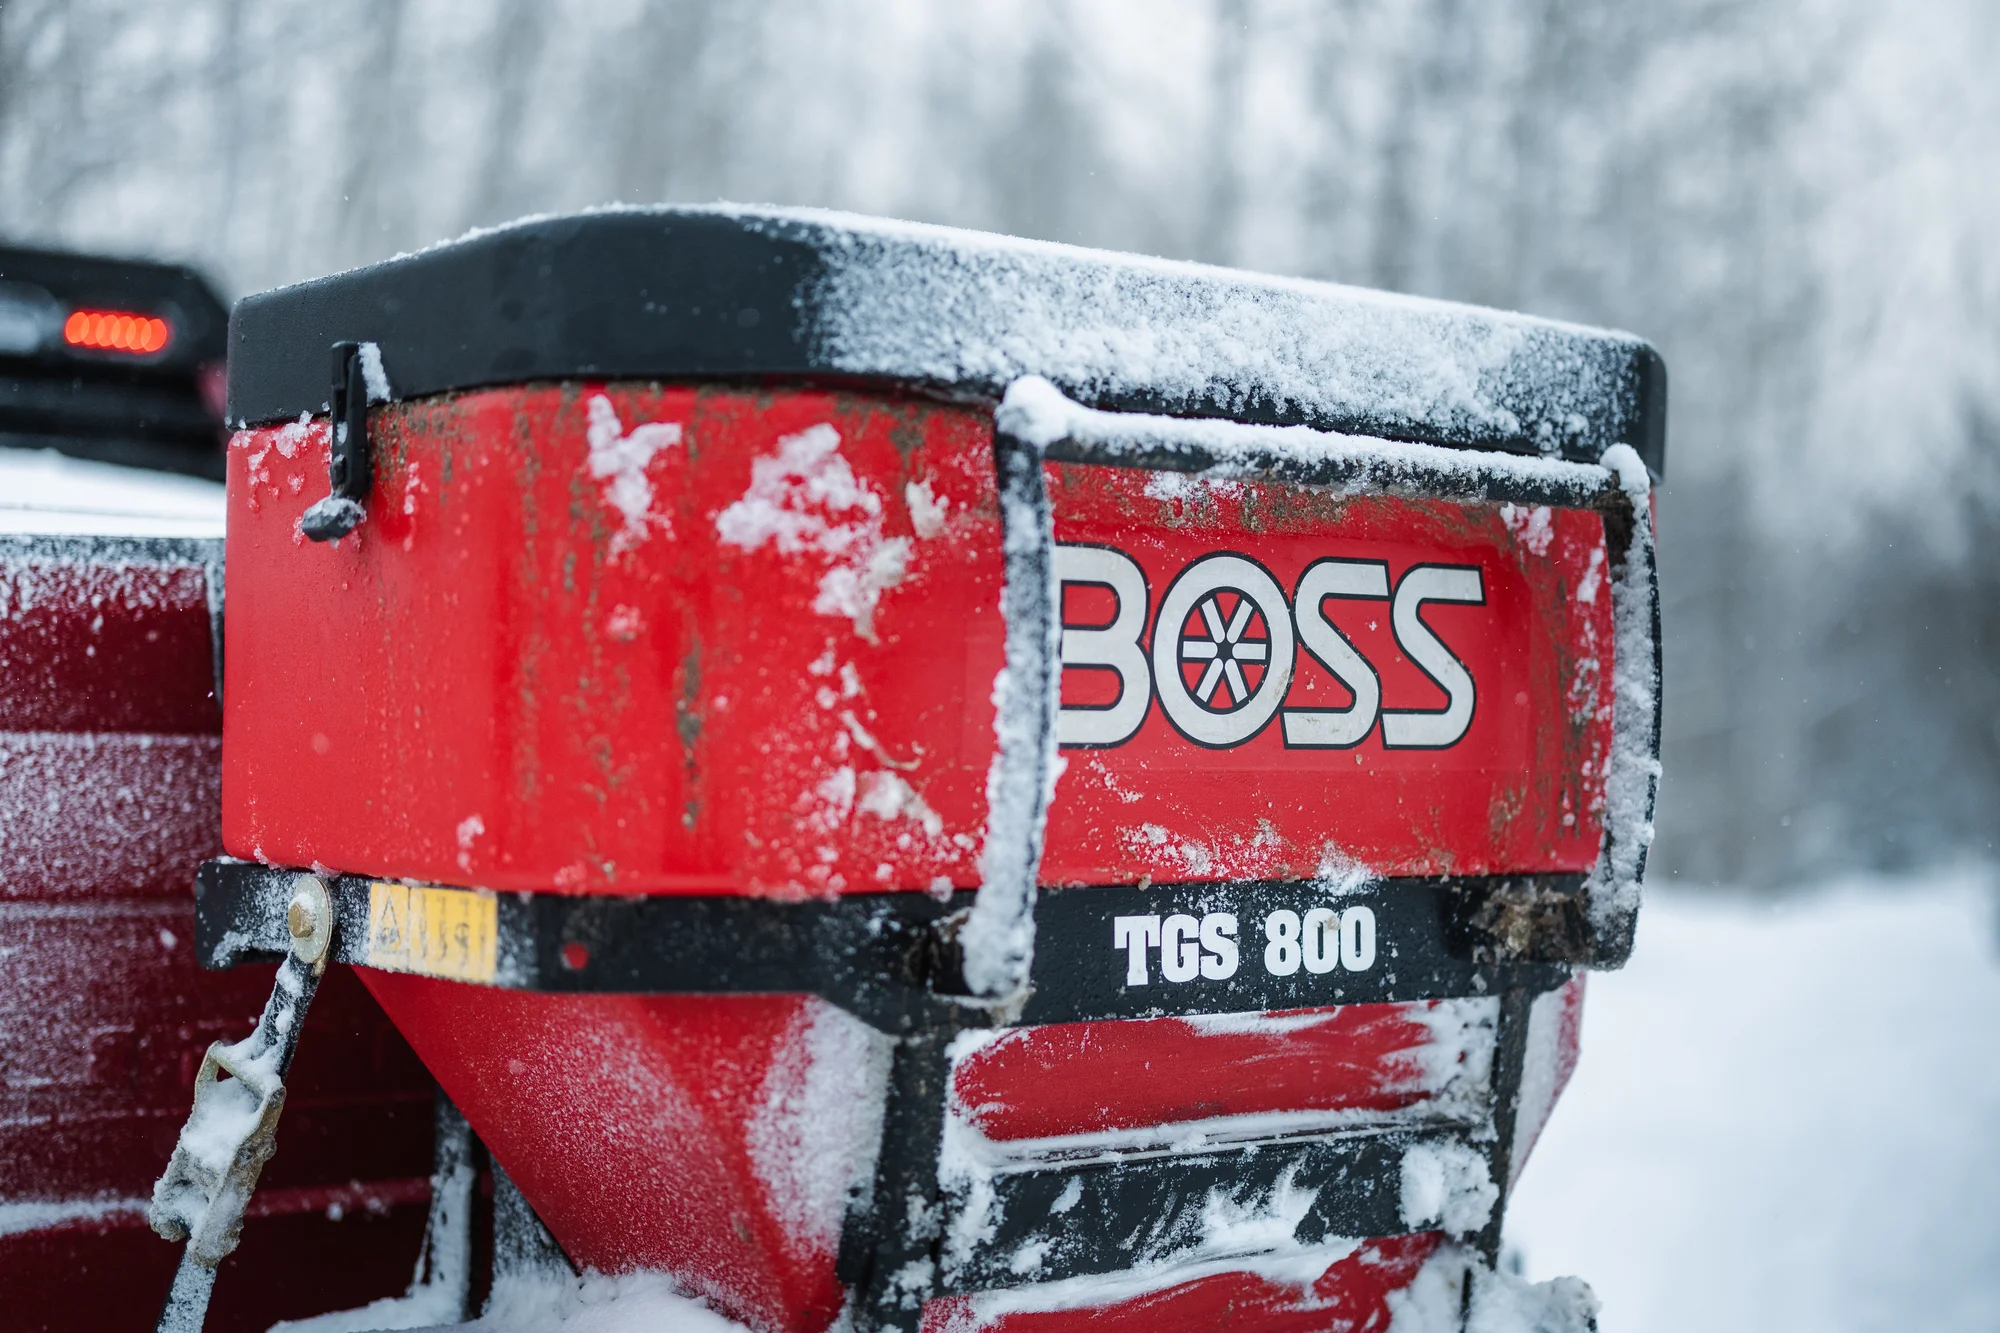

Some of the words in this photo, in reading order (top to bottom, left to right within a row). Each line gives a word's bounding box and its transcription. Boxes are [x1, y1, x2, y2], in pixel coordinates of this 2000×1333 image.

[1054, 541, 1487, 750] BOSS
[1114, 913, 1239, 986] TGS
[1264, 906, 1376, 976] 800
